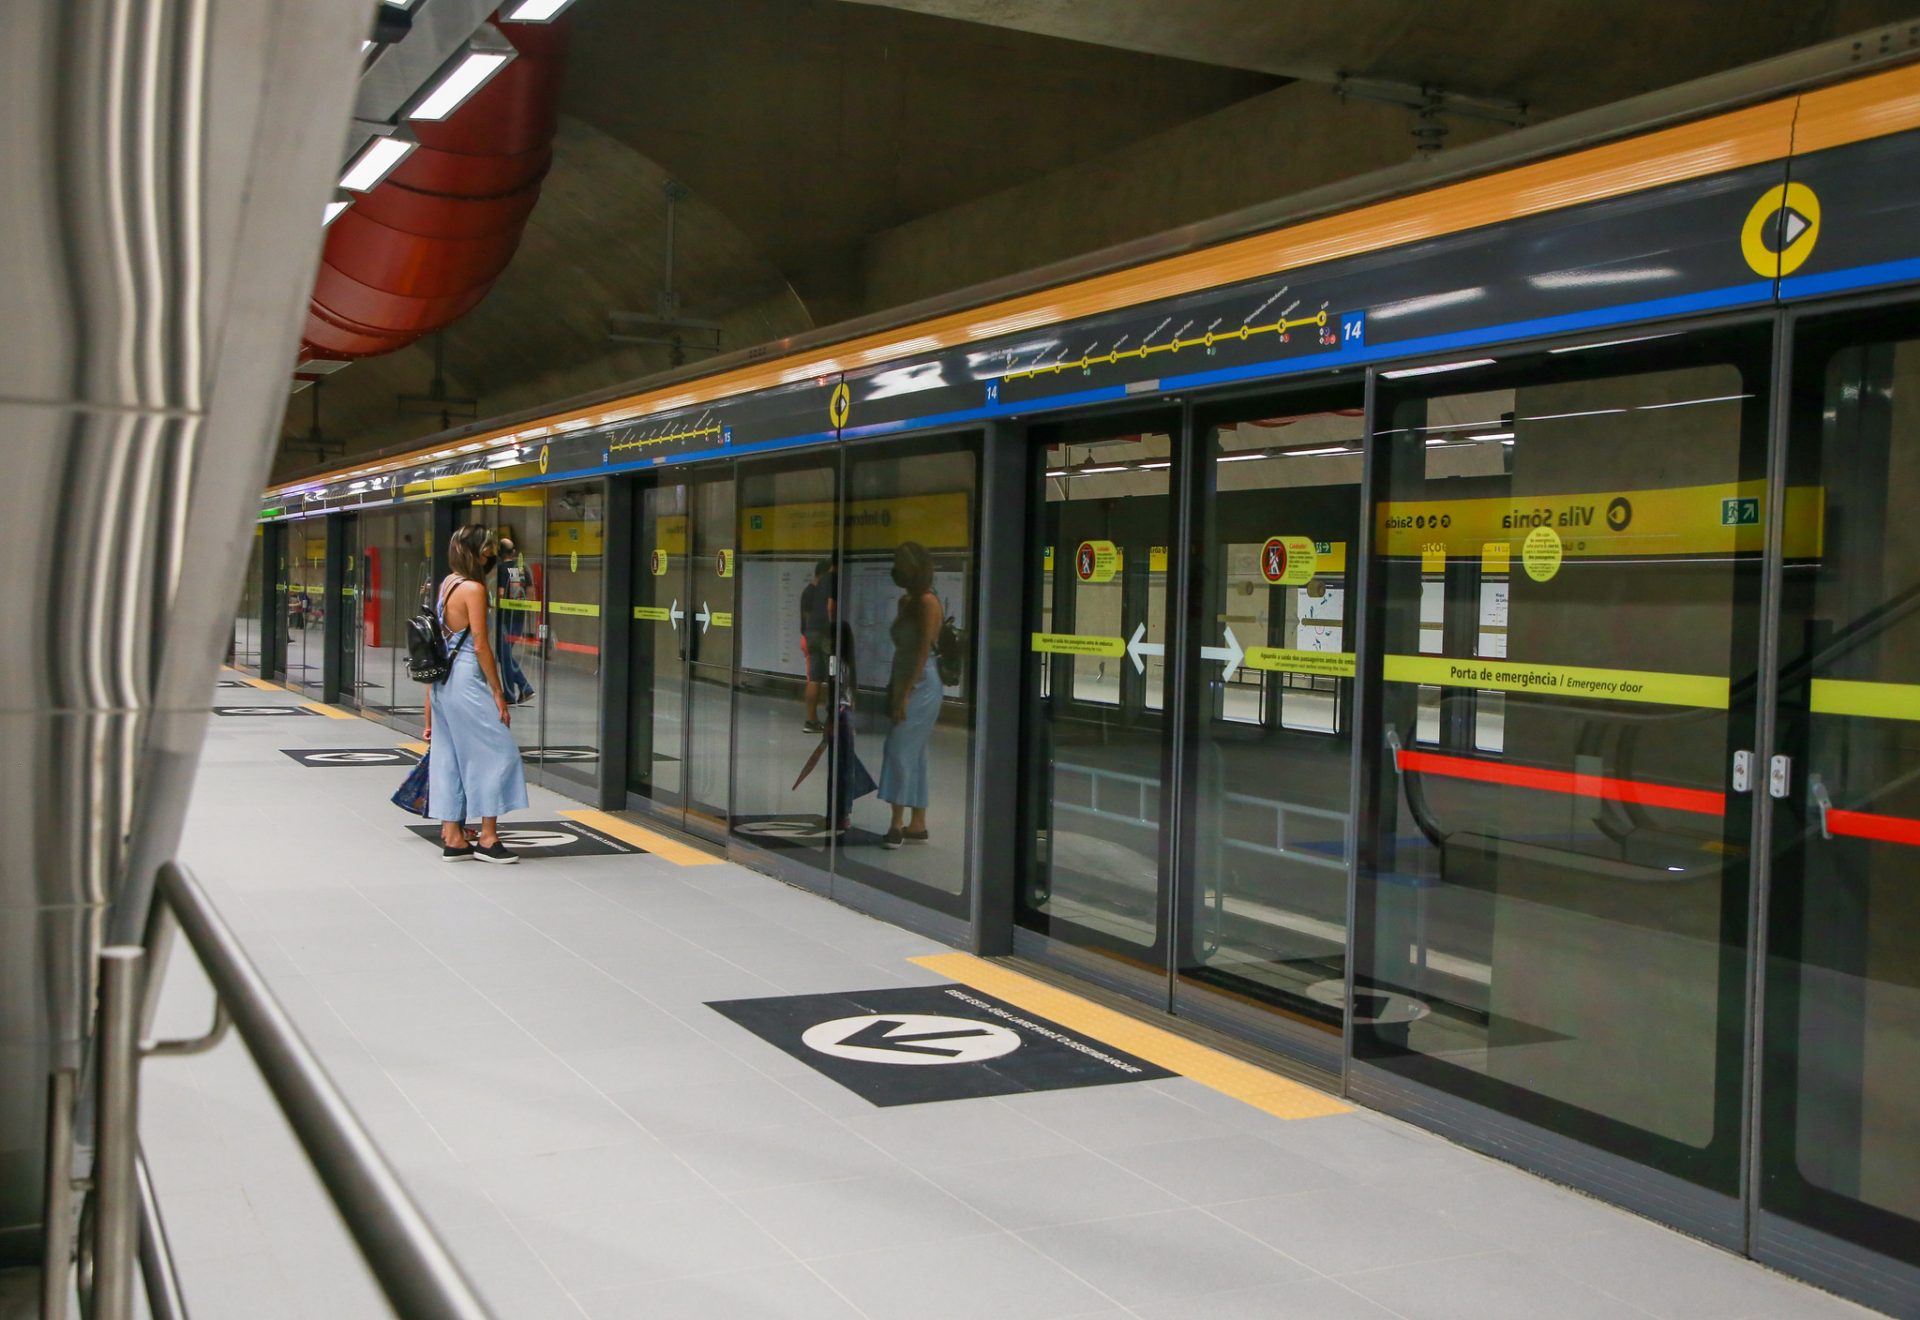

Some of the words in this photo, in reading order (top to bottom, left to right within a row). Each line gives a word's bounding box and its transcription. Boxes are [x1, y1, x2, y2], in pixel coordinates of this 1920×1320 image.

[1344, 320, 1362, 341] 14
[987, 385, 998, 400] 14
[1450, 666, 1477, 680] Porta
[1480, 668, 1492, 681] de
[1496, 671, 1557, 687] emergência
[1567, 677, 1617, 694] Emergency
[1620, 681, 1643, 693] door
